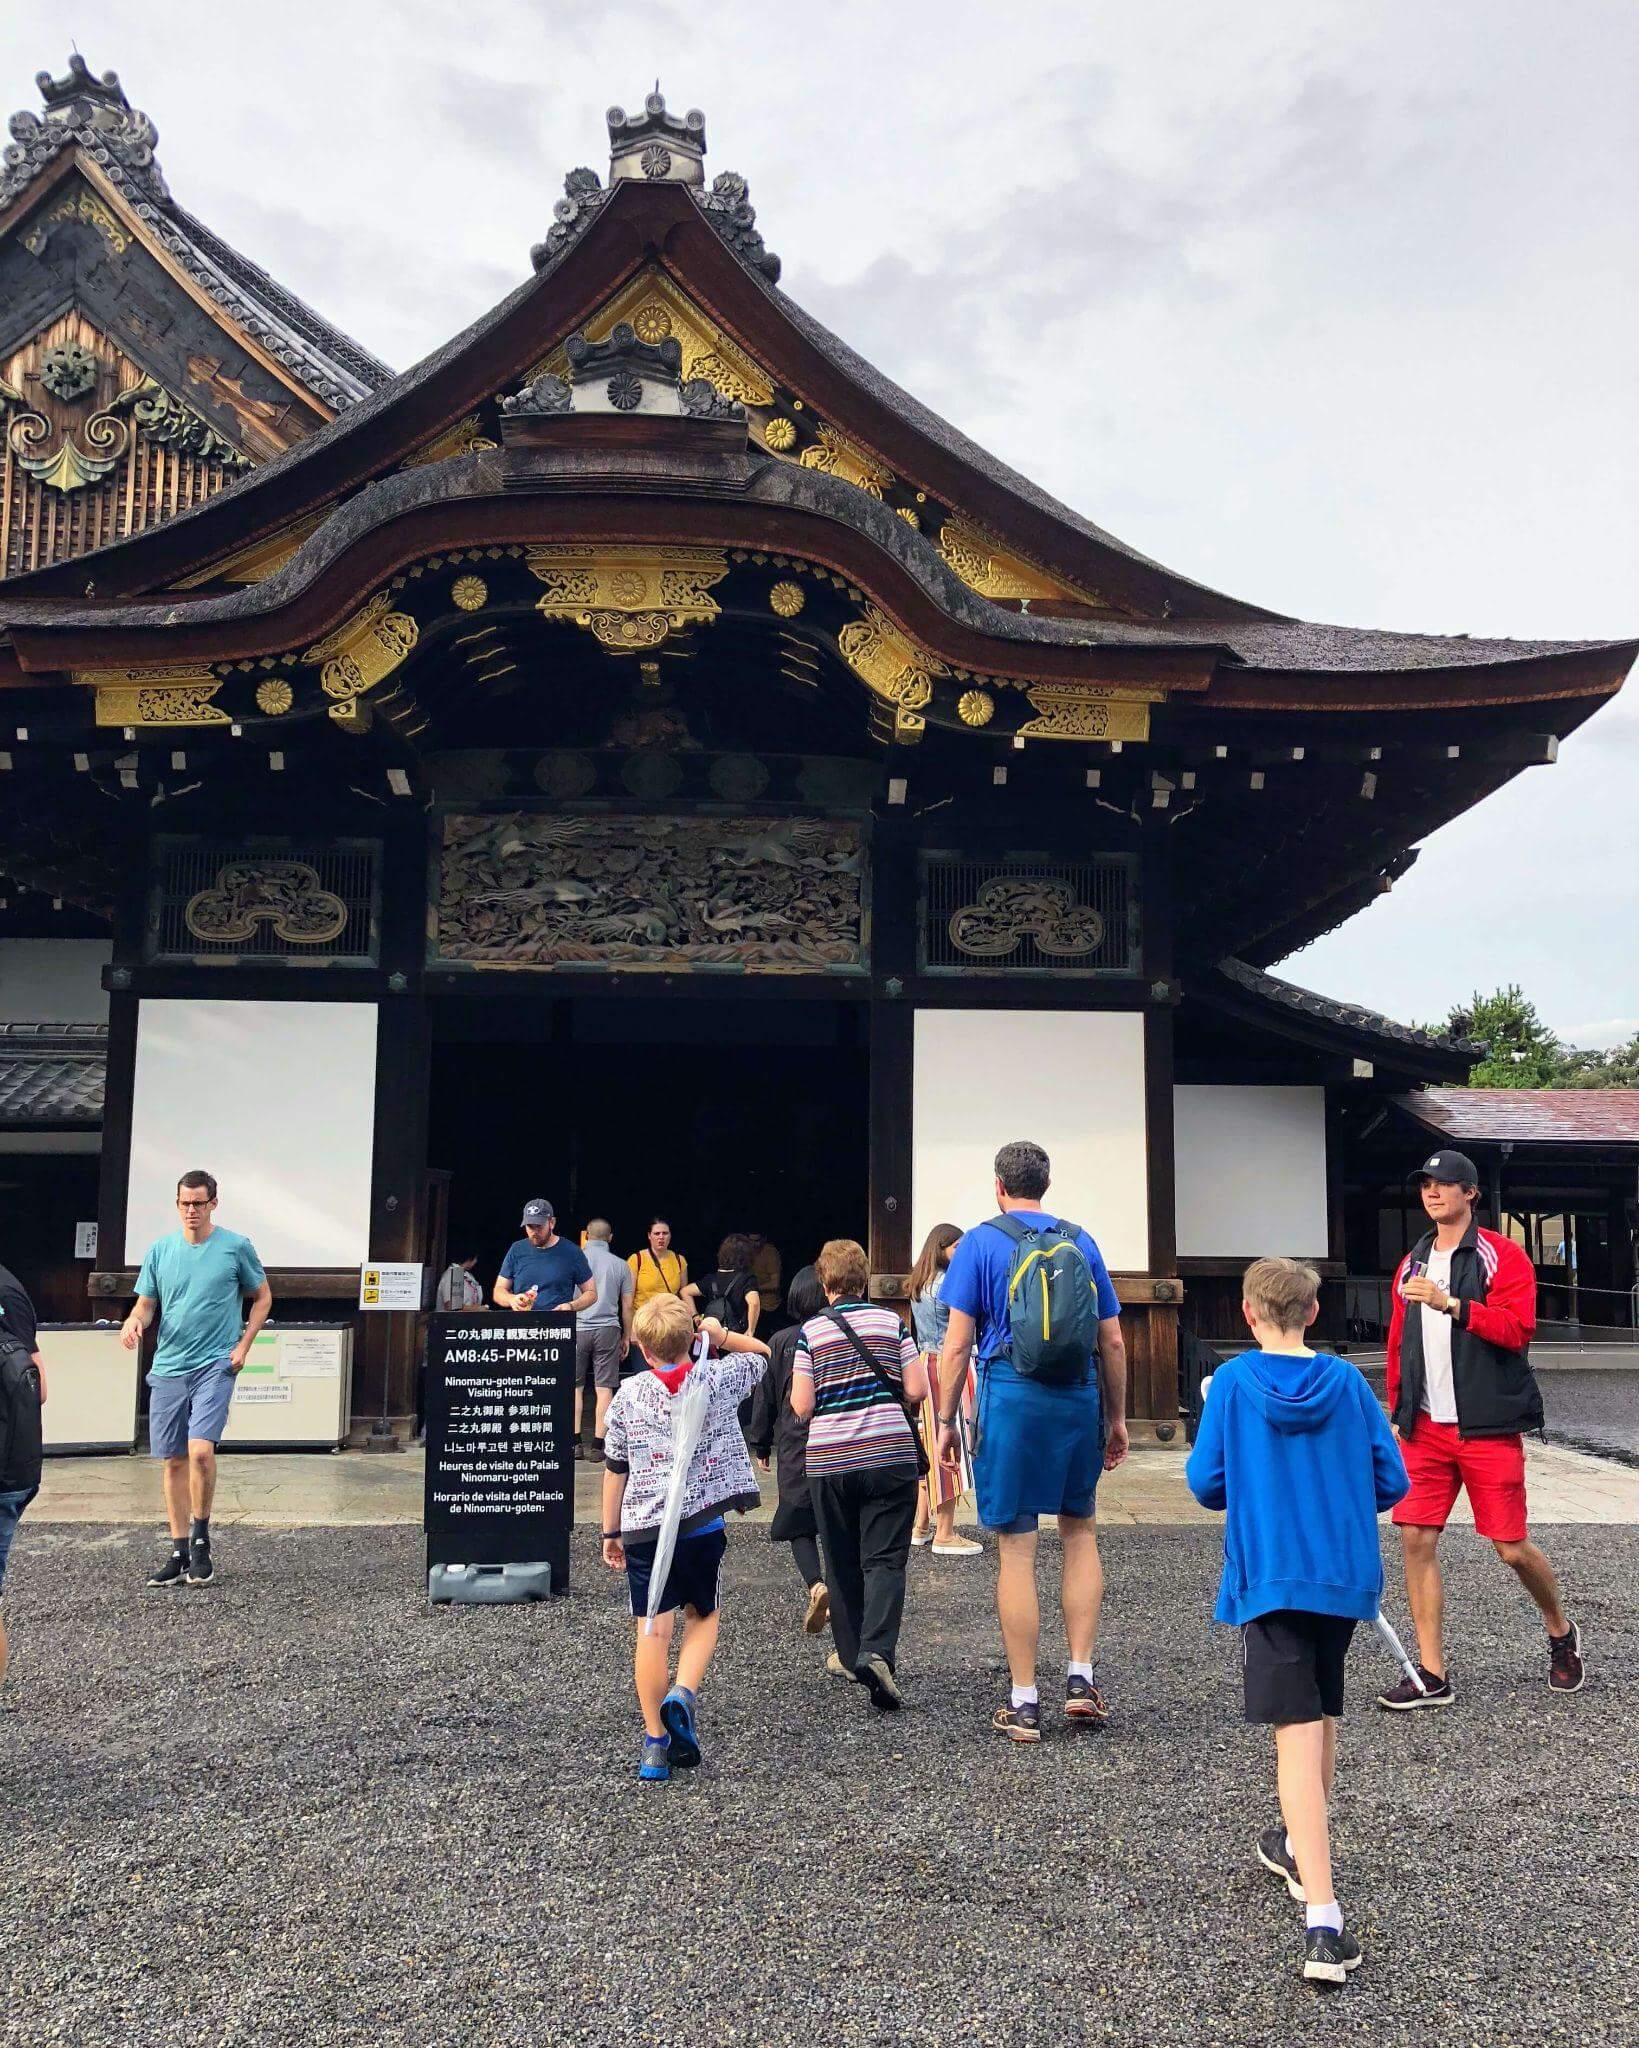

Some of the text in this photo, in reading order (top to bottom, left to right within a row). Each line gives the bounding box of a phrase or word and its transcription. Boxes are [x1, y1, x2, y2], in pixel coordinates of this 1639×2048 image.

[444, 1348, 559, 1363] AM8:45-PM4:10
[445, 1376, 556, 1388] Ninomaru-goten Palace
[468, 1388, 533, 1399] Visiting Hours
[449, 1405, 504, 1417] 二之丸御殿
[448, 1422, 502, 1434] 二之丸御殿
[444, 1440, 555, 1453] 니노마루고텐 관람시간
[439, 1460, 560, 1471] Heures de visite du Palais
[461, 1472, 539, 1484] Ninomaru-goten
[433, 1490, 564, 1502] Horario de visita del Palacio
[450, 1503, 545, 1515] de Ninomaru-goten:
